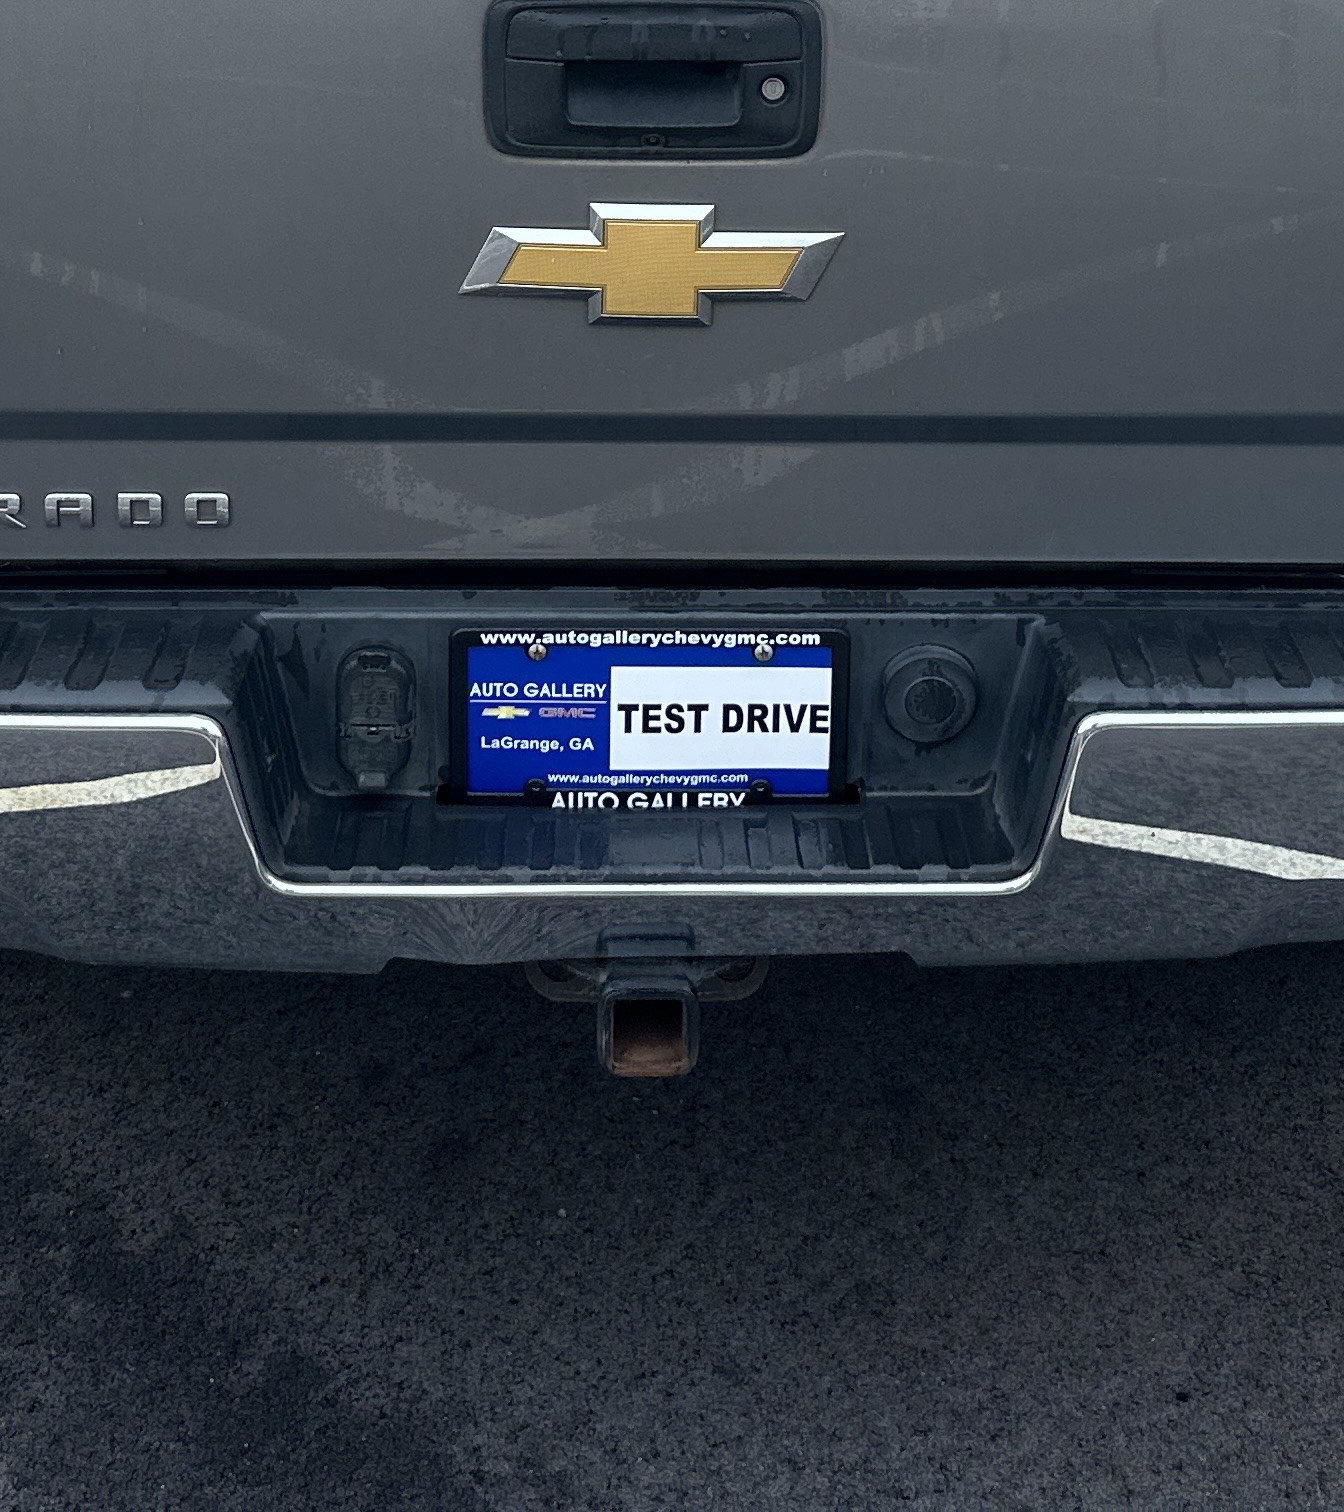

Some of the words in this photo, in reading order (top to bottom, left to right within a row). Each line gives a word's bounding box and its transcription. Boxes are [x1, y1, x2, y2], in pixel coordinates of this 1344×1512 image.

[480, 630, 821, 648] www.autogallerychevygmc.com
[469, 682, 519, 698] AUTO
[523, 682, 607, 698] GALLERY
[538, 707, 597, 719] GMC
[617, 703, 709, 734] TEST
[722, 703, 830, 734] DRIVE
[481, 736, 564, 752] LaGrange,
[569, 738, 595, 751] GA
[547, 773, 749, 785] www.autogallerychevygmc.com
